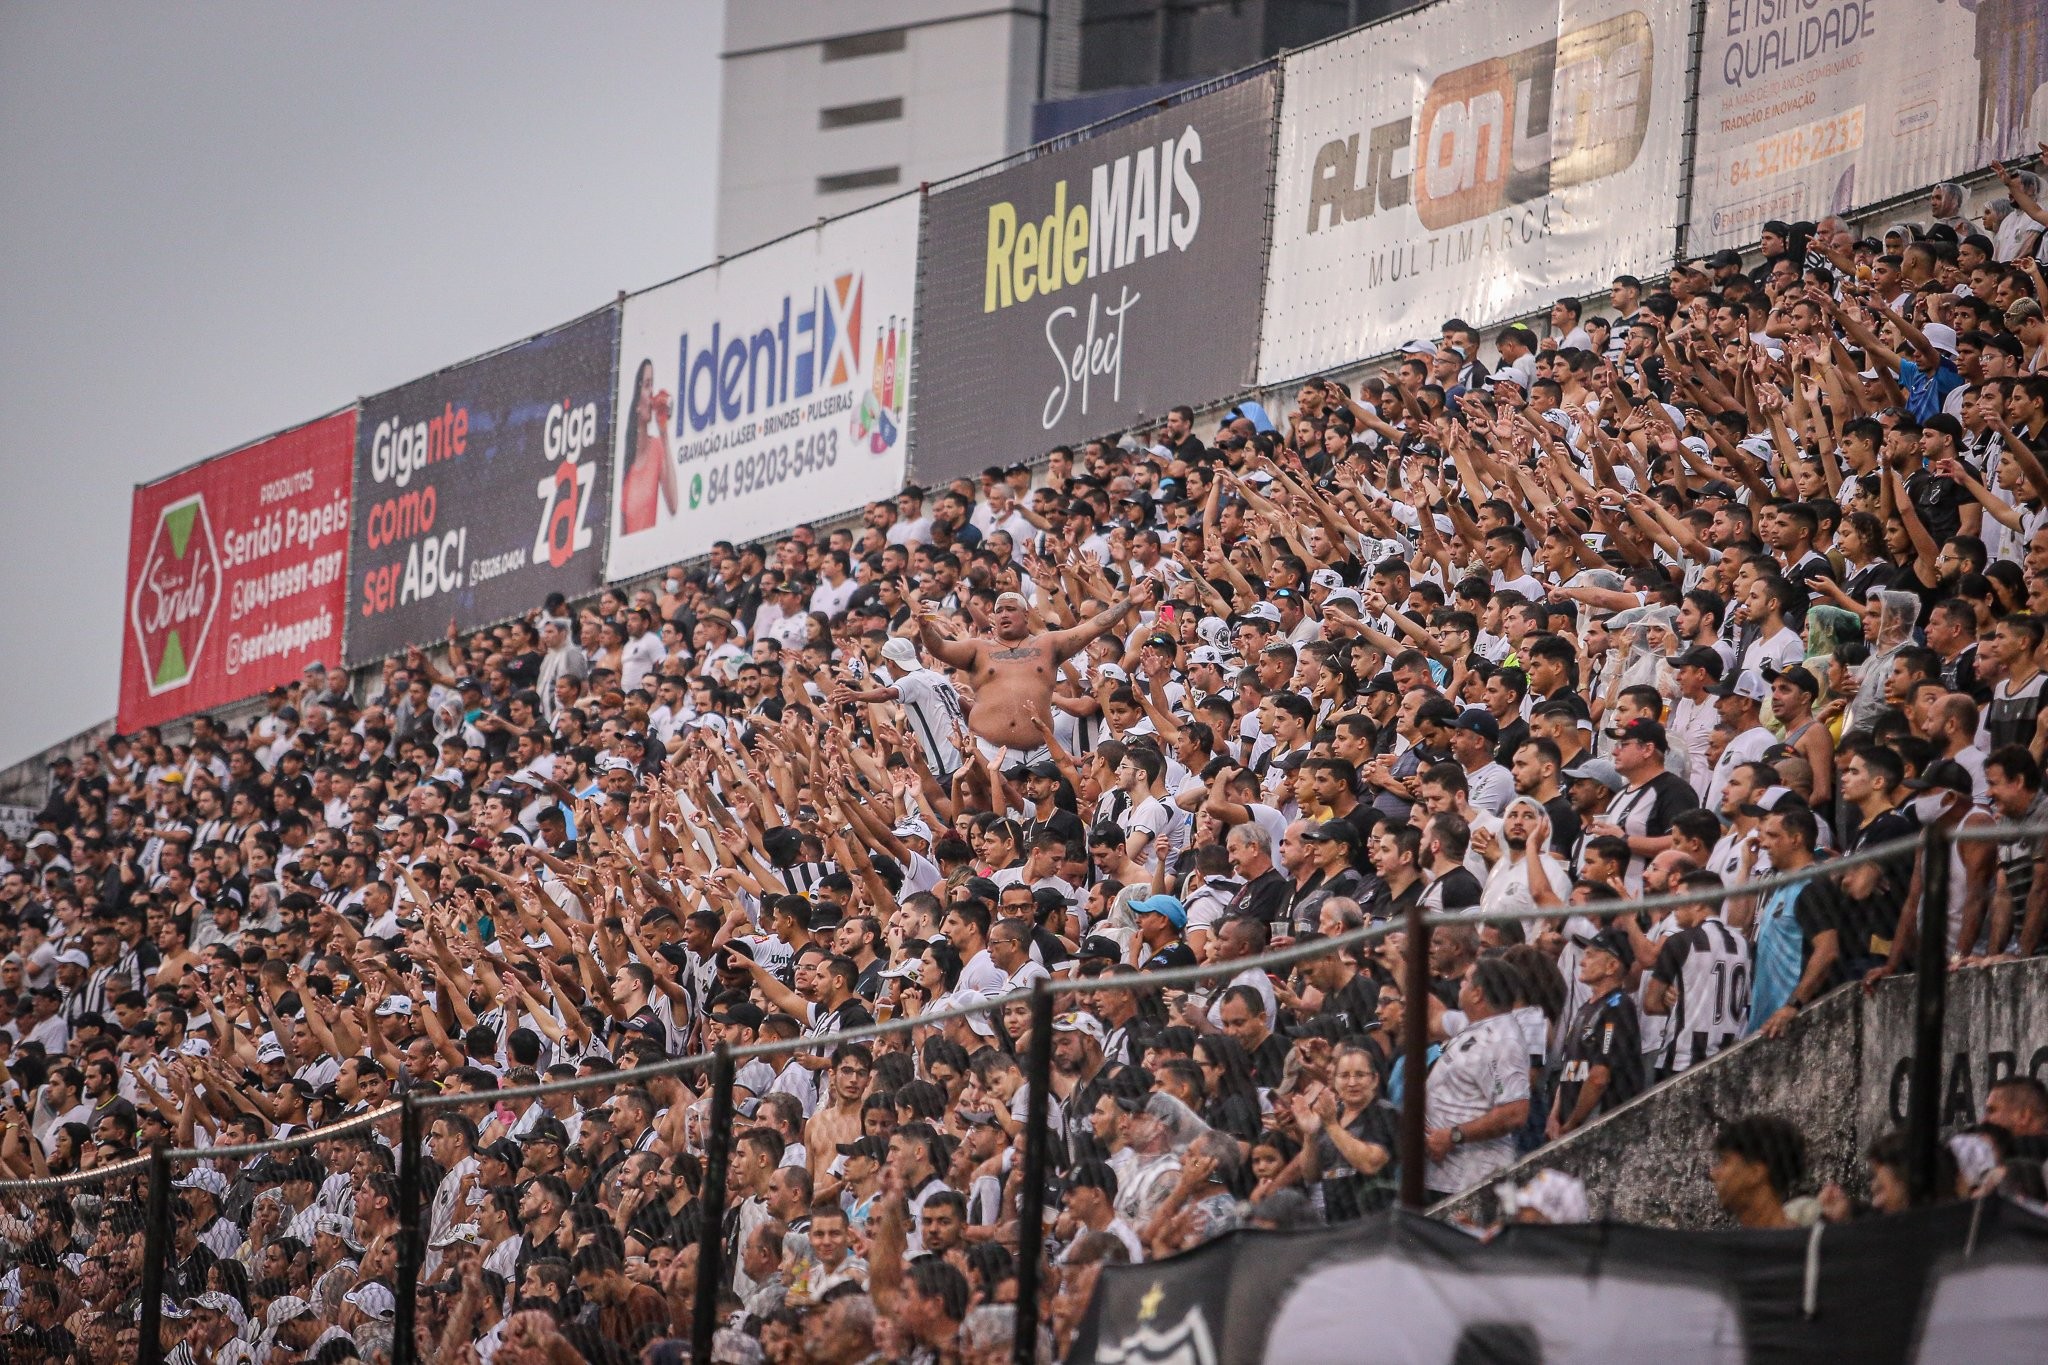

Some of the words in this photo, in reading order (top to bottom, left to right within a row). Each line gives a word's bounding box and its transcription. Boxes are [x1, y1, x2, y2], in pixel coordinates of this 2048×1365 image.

[1724, 0, 1875, 88] QUALIDADE
[1727, 0, 1818, 37] ENSI
[1721, 108, 1763, 133] TRADIÇÃO
[1772, 91, 1816, 116] INOVAÇÃO
[1730, 158, 1750, 187] 84
[1042, 285, 1141, 429] Select
[371, 401, 469, 487] Gigante
[543, 398, 597, 464] Giga
[677, 431, 721, 465] GRAVAÇÃO
[722, 433, 729, 451] A
[731, 423, 757, 448] LASER
[763, 408, 801, 437] BRINDES
[807, 390, 853, 423] PULSEIRAS
[260, 466, 314, 506] PRODUTOS
[706, 462, 729, 505] 84
[733, 428, 838, 498] 99203-5493
[223, 509, 282, 570] Seridó
[285, 487, 348, 550] Papeis
[367, 485, 437, 551] como
[362, 562, 401, 618] ser
[400, 526, 467, 606] ABC!
[771, 954, 791, 964] Uni
[1711, 960, 1747, 1026] 10
